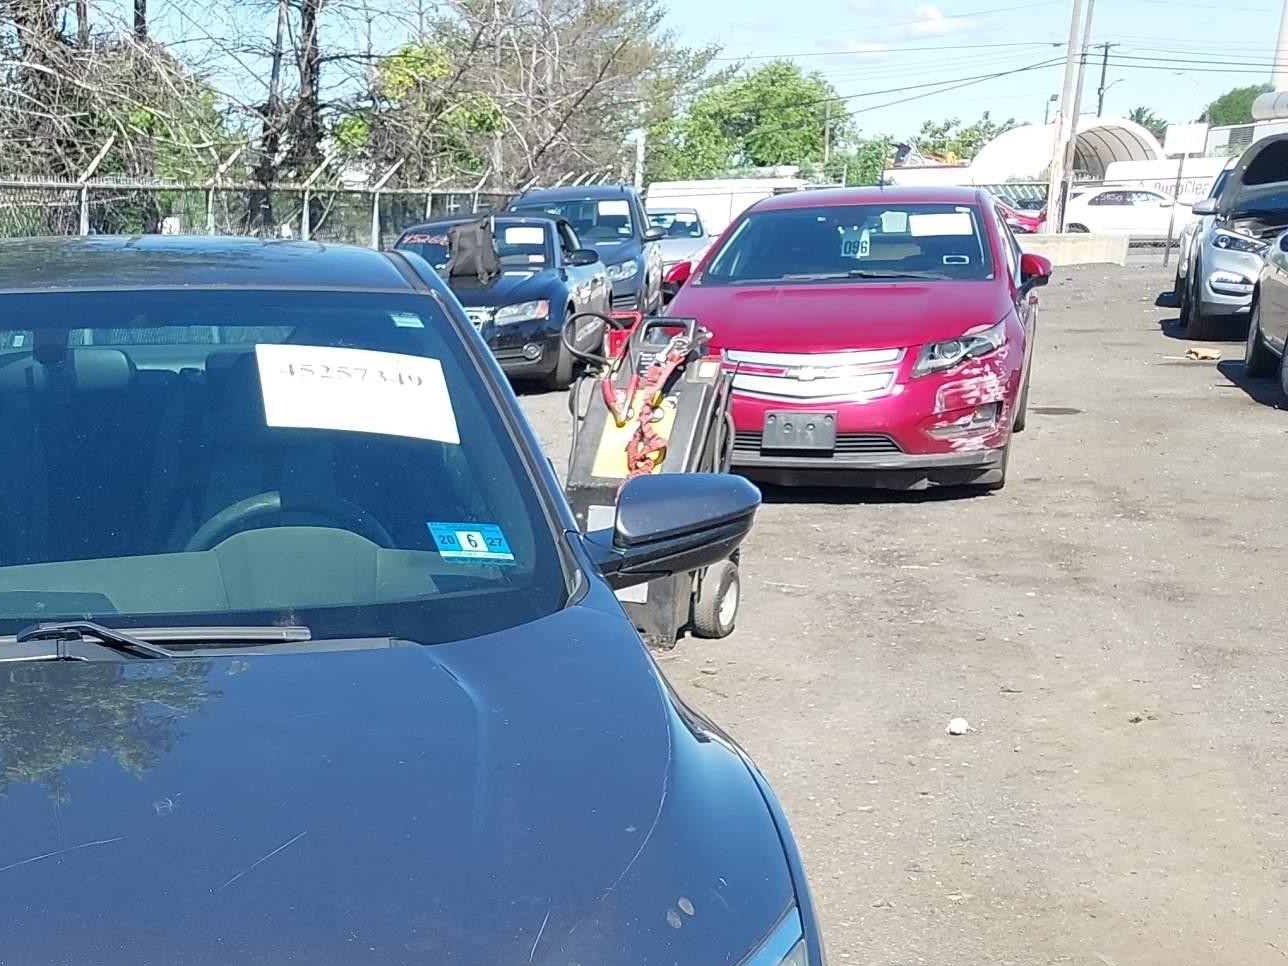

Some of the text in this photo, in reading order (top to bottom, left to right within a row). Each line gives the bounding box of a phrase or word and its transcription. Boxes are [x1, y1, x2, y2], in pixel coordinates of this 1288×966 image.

[843, 240, 868, 255] 096
[438, 533, 503, 548] 20 6 27
